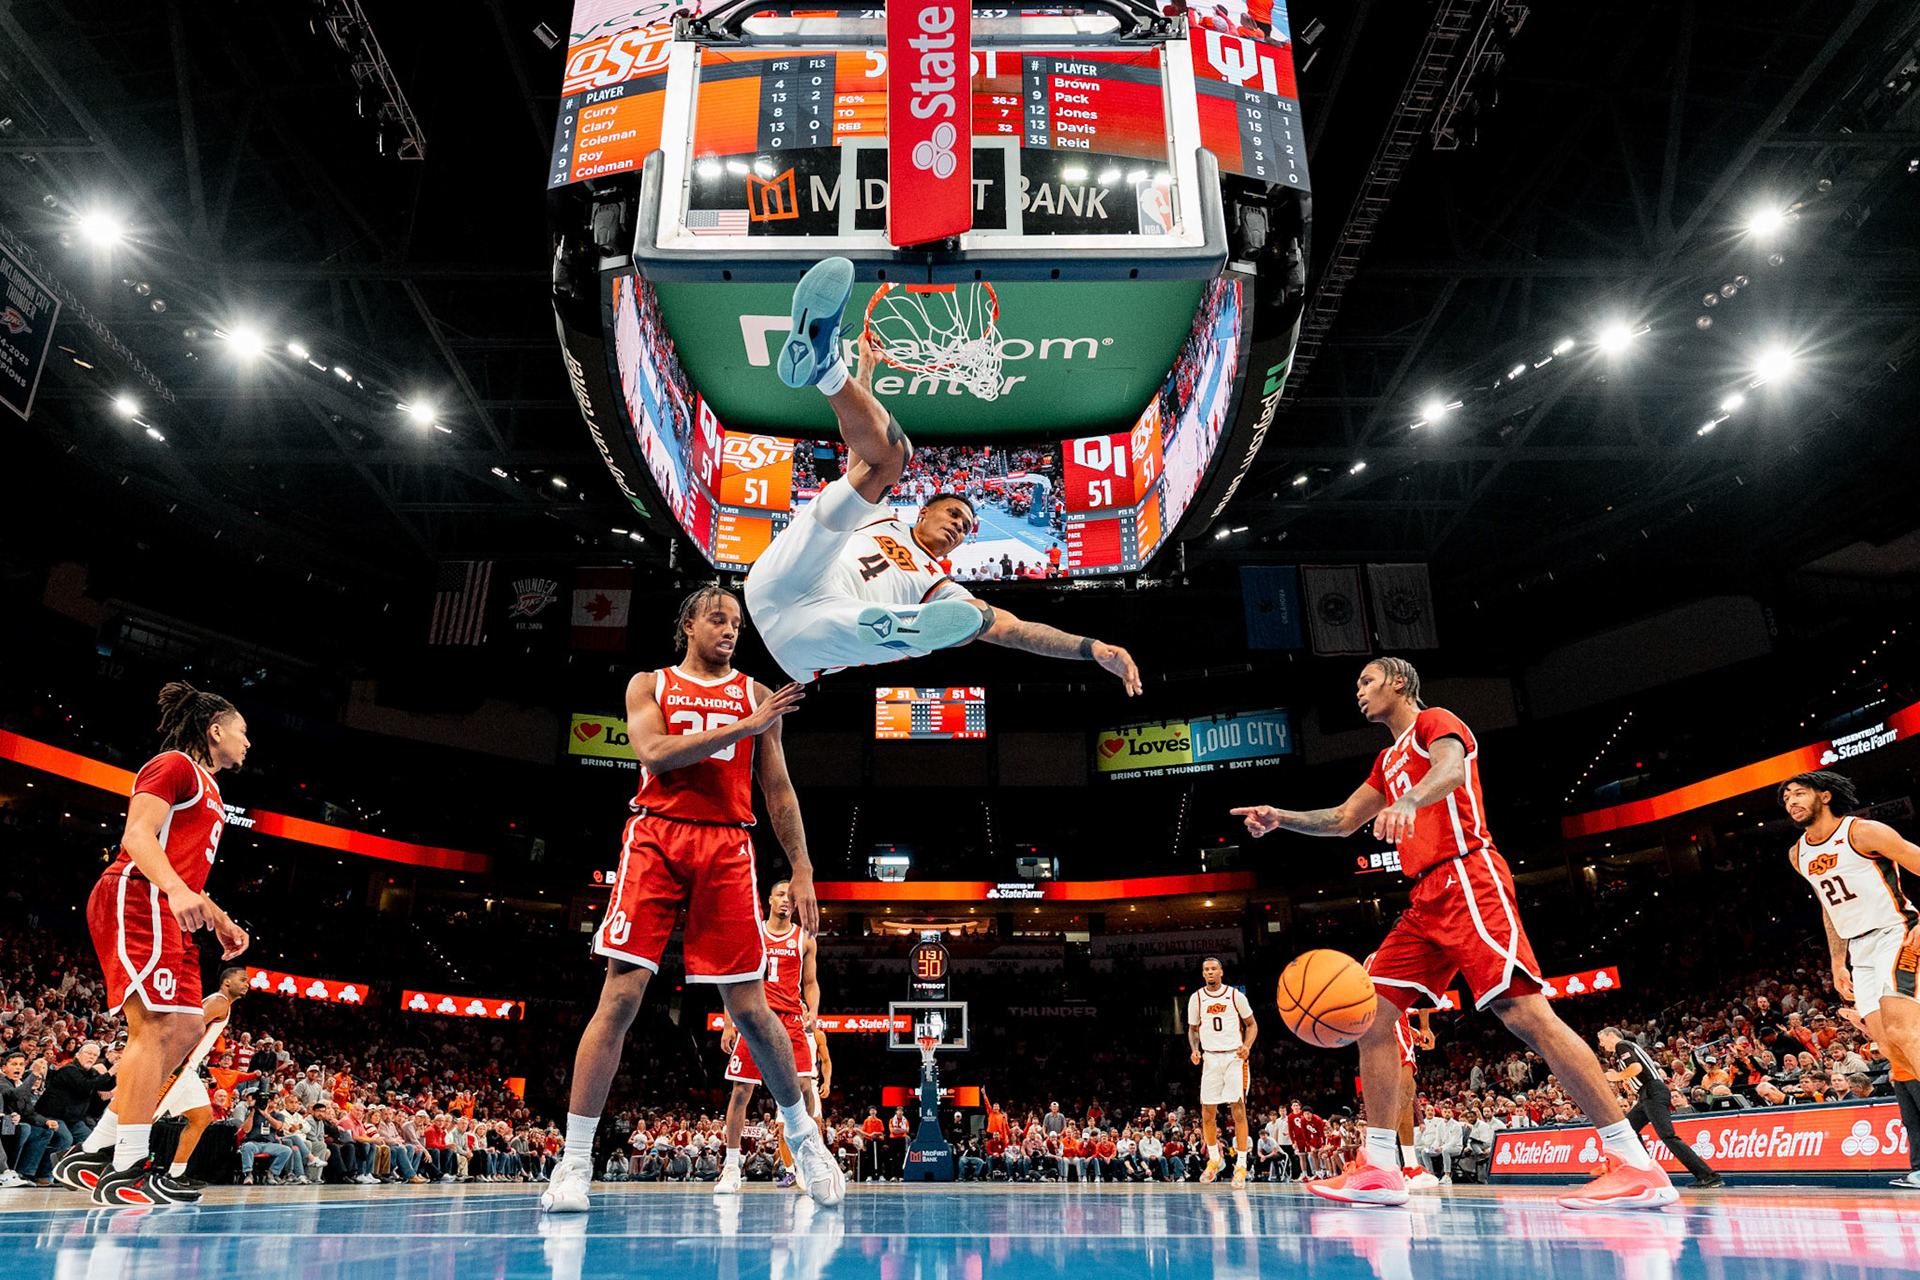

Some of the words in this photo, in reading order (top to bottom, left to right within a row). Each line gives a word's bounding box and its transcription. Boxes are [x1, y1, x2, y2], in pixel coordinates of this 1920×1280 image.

[772, 62, 790, 72] PTS
[809, 59, 826, 70] FLS
[865, 50, 888, 78] 5
[908, 6, 956, 119] State
[1055, 62, 1098, 77] PLAYER
[774, 79, 785, 89] 4
[811, 76, 822, 86] 0
[1033, 76, 1040, 86] 1
[1055, 77, 1101, 91] Brown
[586, 86, 624, 104] PLAYER
[771, 92, 787, 103] 13
[811, 91, 821, 101] 2
[838, 95, 865, 105] FG%
[992, 96, 1018, 105] 36.2
[1032, 91, 1042, 101] 9
[1055, 92, 1090, 105] Pack
[1245, 92, 1261, 104] PTS
[1277, 101, 1293, 112] FLS
[563, 115, 574, 126] 0
[583, 104, 619, 121] Curry
[773, 107, 783, 117] 8
[812, 105, 819, 115] 1
[837, 108, 855, 118] TO
[1001, 109, 1010, 118] 7
[1029, 105, 1046, 115] 12
[1055, 106, 1098, 120] Jones
[1246, 109, 1262, 120] 10
[1283, 117, 1290, 126] 1
[563, 130, 570, 139] 1
[582, 118, 615, 134] Clary
[769, 122, 786, 132] 13
[809, 120, 820, 130] 0
[837, 122, 862, 131] REB
[998, 124, 1013, 133] 32
[1030, 119, 1046, 130] 13
[1056, 121, 1097, 135] Davis
[1248, 121, 1263, 133] 15
[1285, 130, 1292, 140] 1
[560, 144, 569, 154] 4
[580, 129, 637, 149] Coleman
[771, 137, 782, 148] 0
[811, 135, 818, 145] 1
[1029, 135, 1048, 146] 35
[1056, 136, 1090, 149] Reid
[1252, 136, 1262, 147] 9
[1286, 144, 1295, 155] 2
[558, 158, 567, 168] 9
[578, 149, 604, 164] Roy
[1254, 150, 1264, 161] 3
[1289, 159, 1296, 169] 1
[553, 172, 568, 184] 21
[575, 158, 633, 178] Coleman
[1256, 165, 1265, 176] 5
[1288, 173, 1299, 184] 0
[0, 257, 36, 301] OKLAHOMA
[35, 292, 51, 314] CITY
[5, 281, 38, 321] THUNDER
[0, 335, 30, 367] 4-2025
[0, 361, 27, 388] PIONS
[701, 451, 713, 488] 51
[1143, 451, 1155, 490] 51
[744, 478, 769, 506] 51
[1088, 479, 1112, 508] 51
[721, 506, 739, 514] PLAYER
[858, 552, 891, 583] 4
[511, 578, 558, 596] THUNDER
[897, 689, 910, 699] 51
[952, 689, 966, 699] 51
[667, 694, 744, 713] OKLAHOMA
[1196, 722, 1241, 757] LOUD
[1247, 721, 1287, 748] CITY
[1831, 728, 1875, 748] PRESENTED
[1874, 722, 1884, 733] BY
[581, 758, 614, 768] BRING
[616, 761, 637, 770] THE
[1110, 771, 1142, 780] BRING
[1143, 768, 1164, 777] THE
[1165, 764, 1214, 775] THUNDER
[1229, 760, 1253, 769] EXIT
[1255, 757, 1280, 767] NOW
[235, 806, 246, 814] BY
[205, 820, 222, 865] 9
[1370, 850, 1401, 868] BED
[1820, 875, 1858, 907] 21
[768, 956, 780, 983] 1
[918, 960, 941, 977] 30
[1007, 1006, 1098, 1017] THUNDER
[1212, 1016, 1222, 1031] 0
